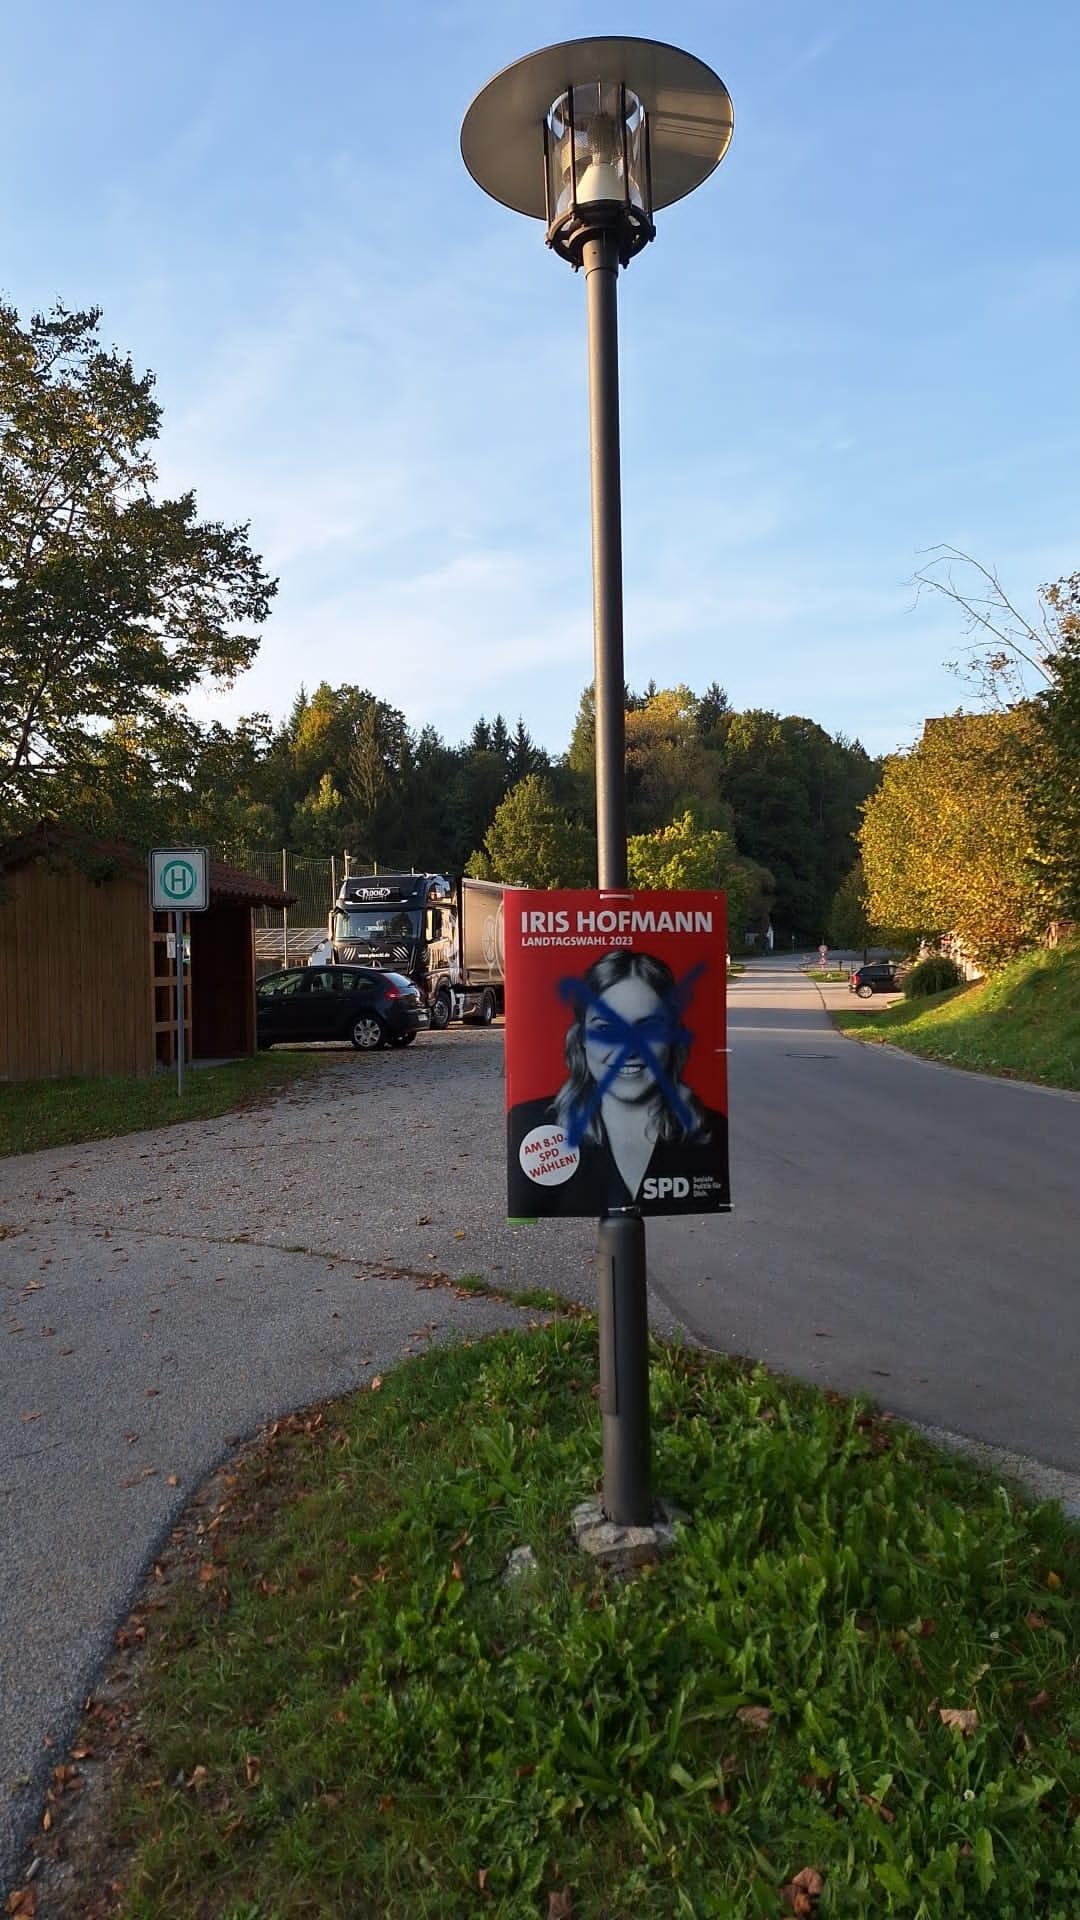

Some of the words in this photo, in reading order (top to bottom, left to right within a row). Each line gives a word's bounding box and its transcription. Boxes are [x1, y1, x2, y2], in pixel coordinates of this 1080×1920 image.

[171, 868, 187, 891] H
[521, 911, 570, 933] IRIS
[577, 910, 713, 933] HOFMANN
[521, 936, 608, 947] LANDTAGSWAHL
[609, 936, 633, 946] 2023
[524, 1141, 542, 1155] AM
[539, 1148, 559, 1162] SPD
[530, 1153, 577, 1177] WÄHLEN!
[643, 1177, 690, 1199] SPD
